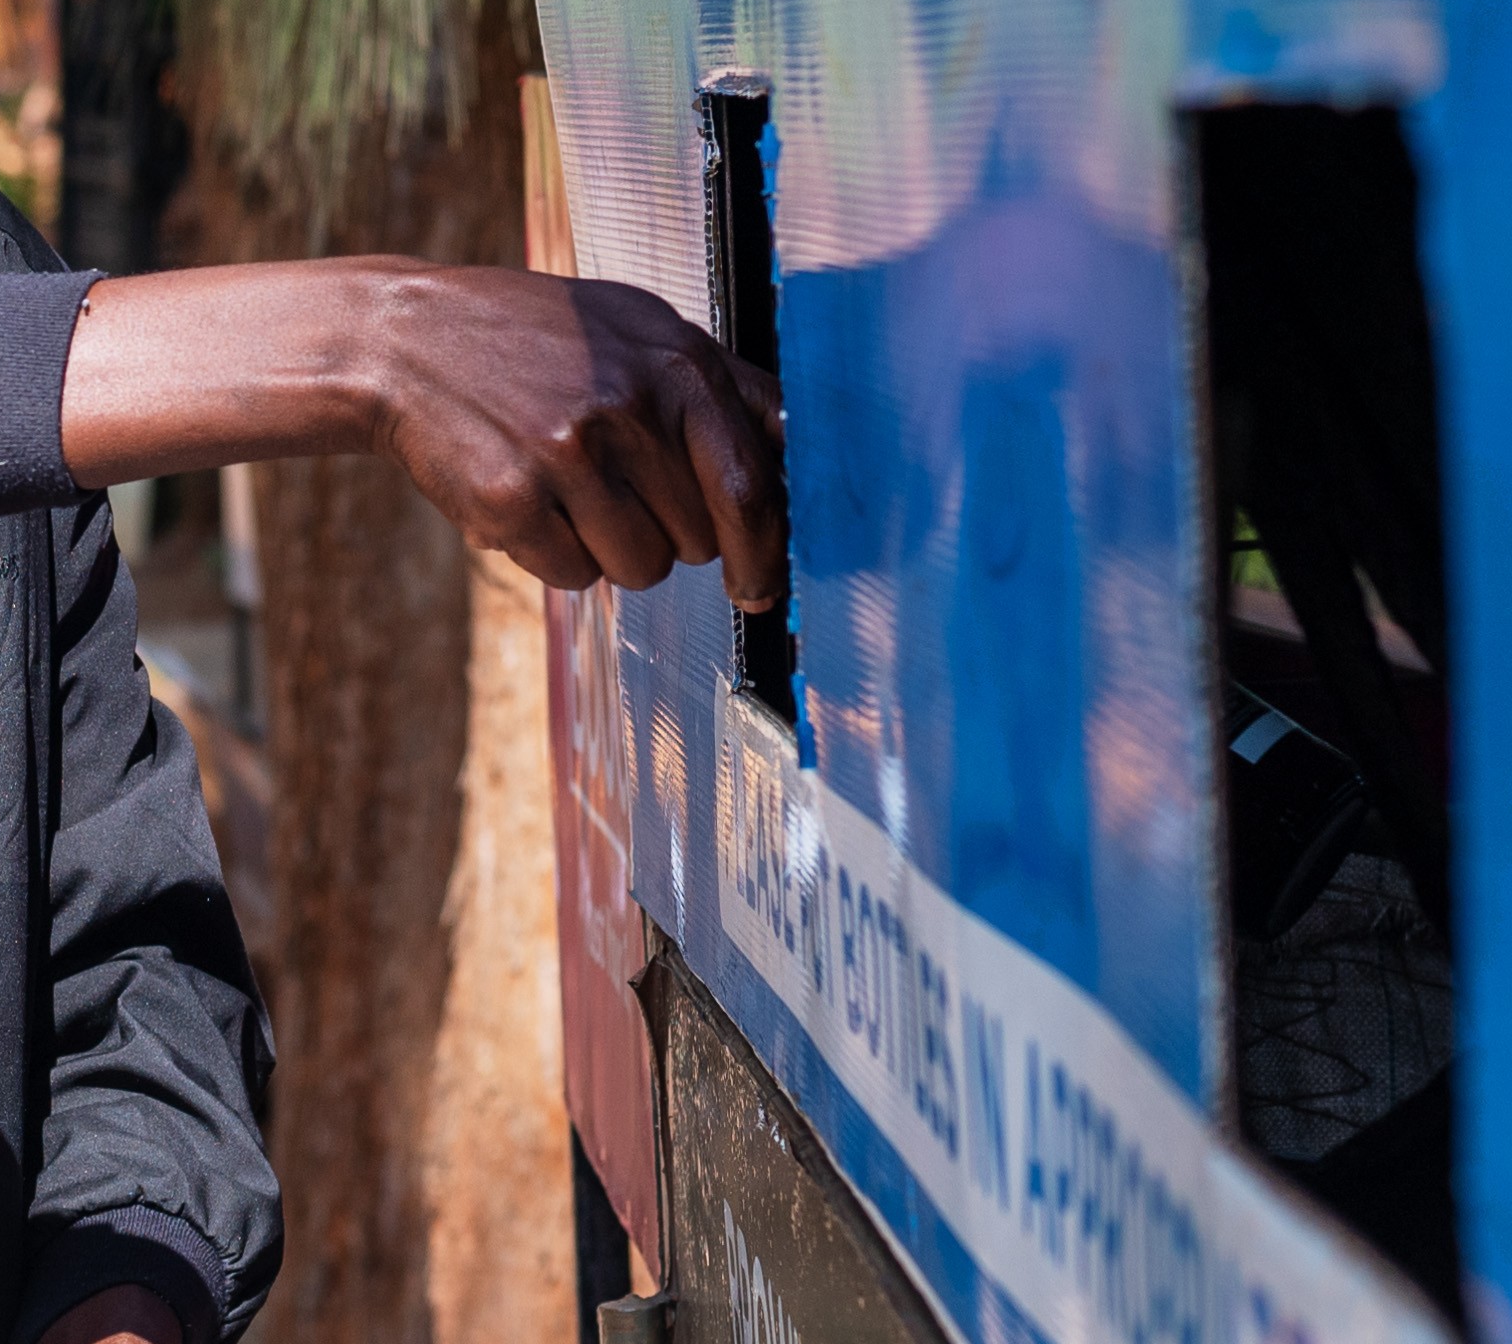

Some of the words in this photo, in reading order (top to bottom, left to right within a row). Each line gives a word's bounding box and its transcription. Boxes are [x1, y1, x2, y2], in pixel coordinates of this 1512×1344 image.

[718, 736, 797, 956] PLEASE
[837, 861, 960, 1164] BOTTLES
[961, 986, 1012, 1214] IN
